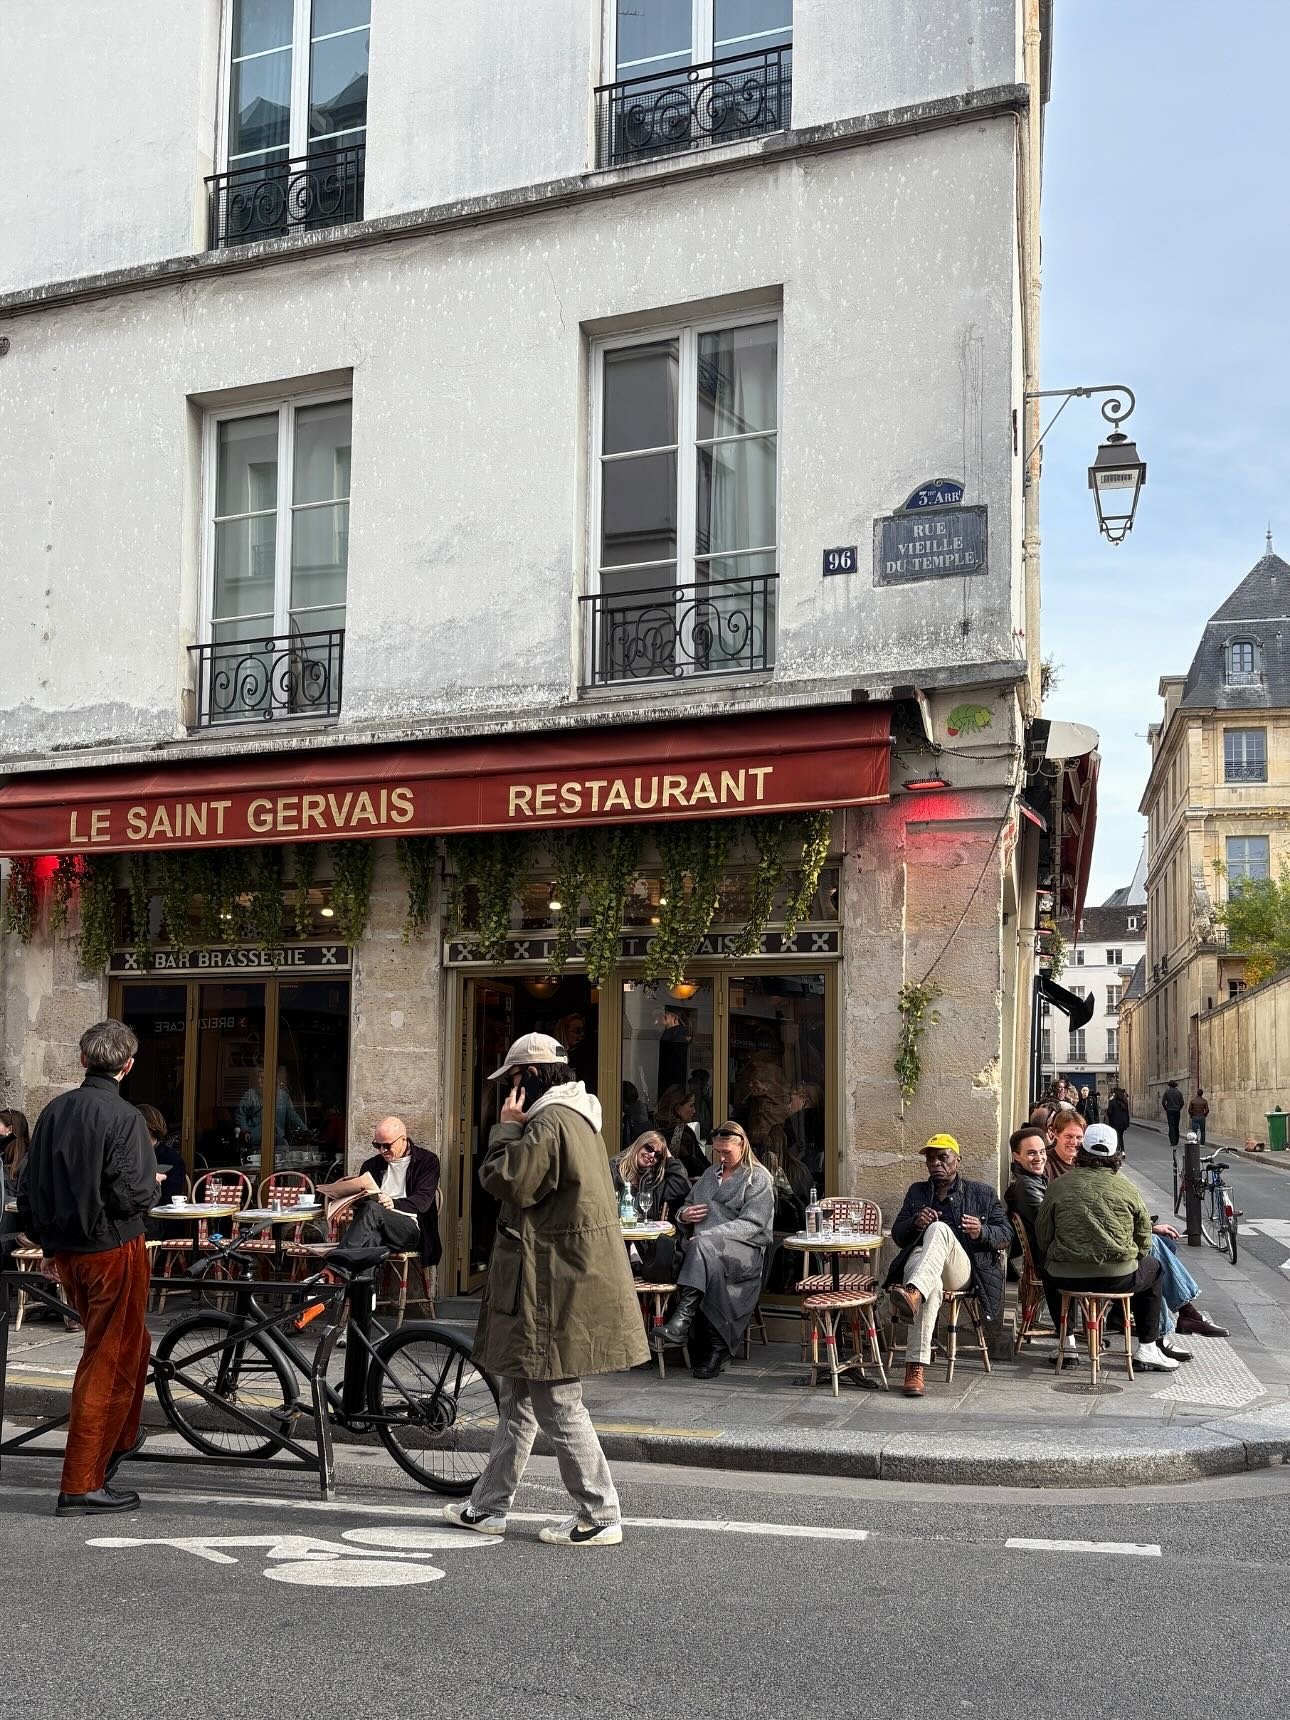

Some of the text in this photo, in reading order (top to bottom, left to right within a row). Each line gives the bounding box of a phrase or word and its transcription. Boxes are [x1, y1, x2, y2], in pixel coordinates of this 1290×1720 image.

[913, 522, 946, 537] RUE
[898, 536, 964, 556] VIEILLE
[828, 551, 851, 570] 96
[886, 560, 907, 574] DU
[70, 766, 774, 843] LE SAINT GERVAIS RESTAURANT
[155, 952, 190, 968] BAR
